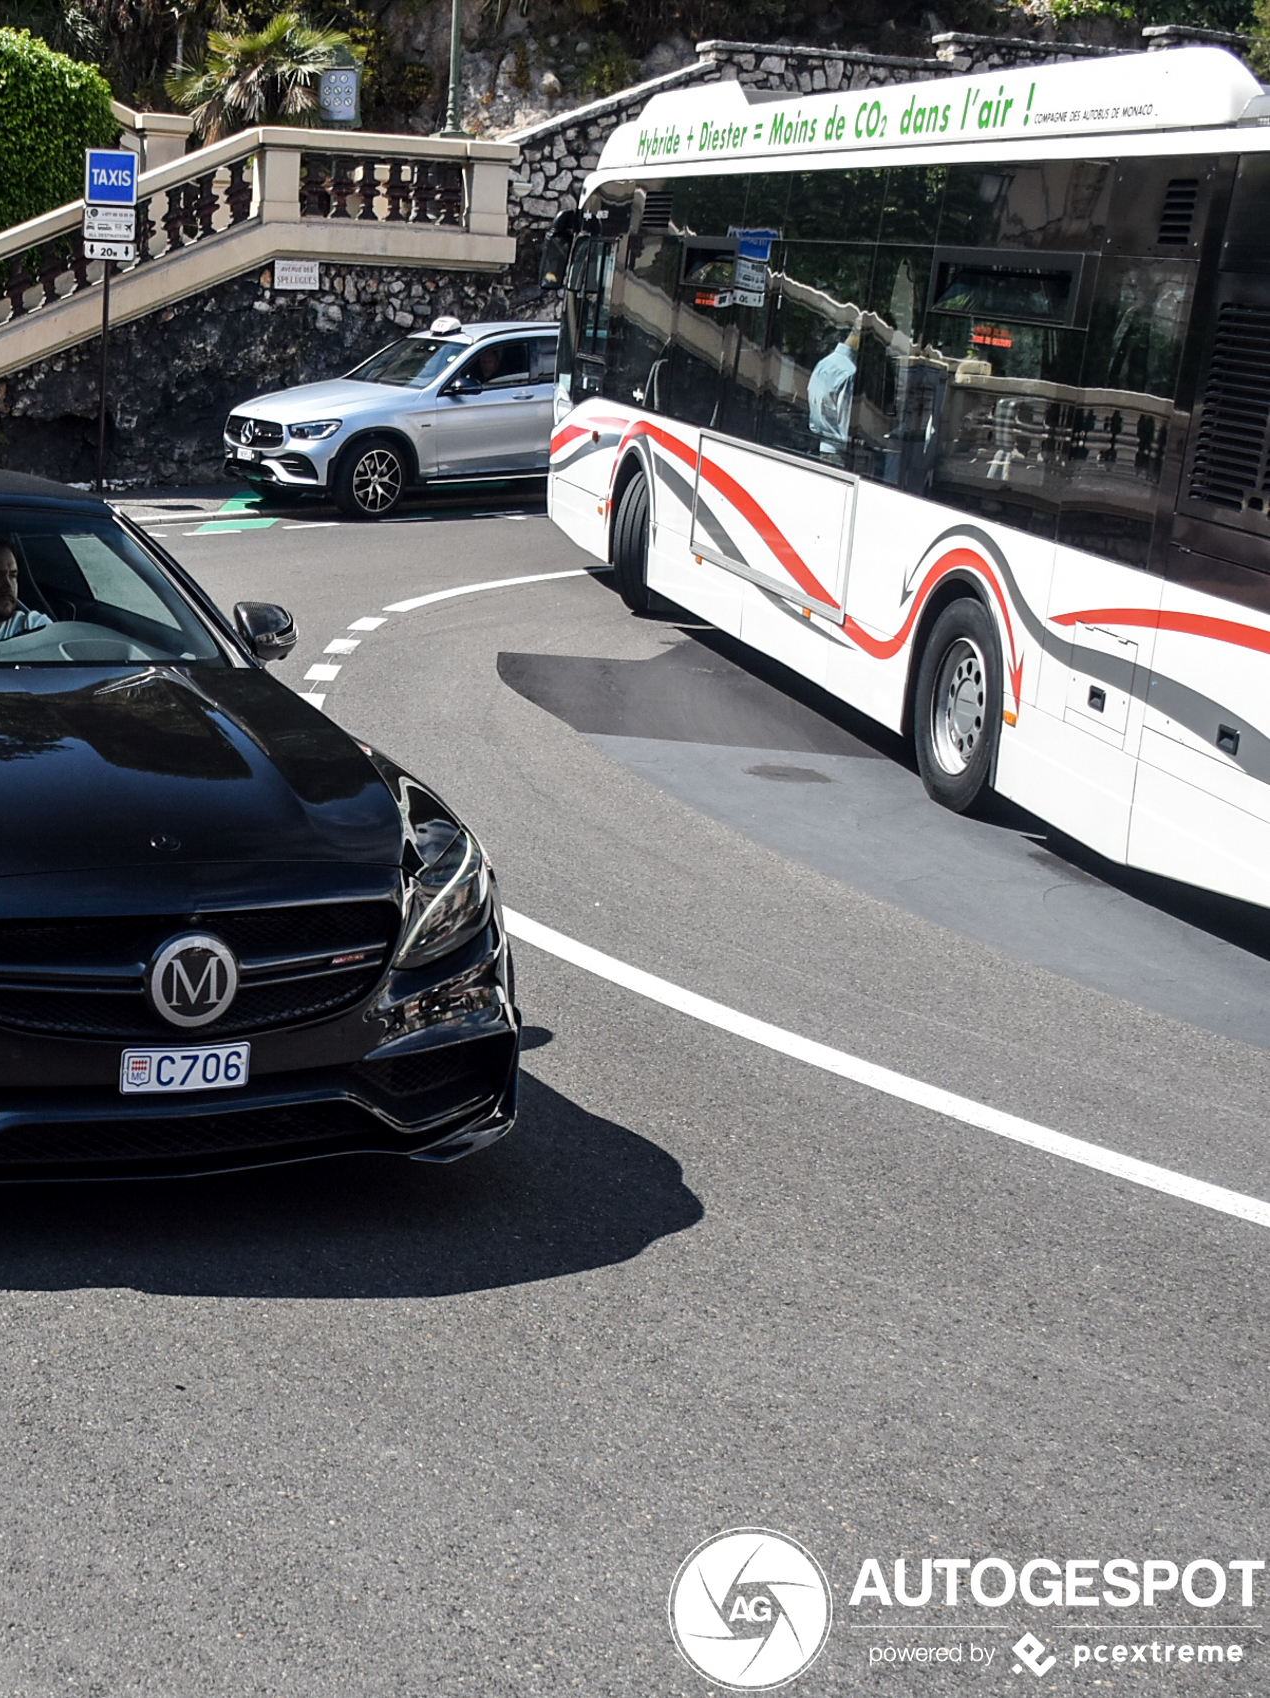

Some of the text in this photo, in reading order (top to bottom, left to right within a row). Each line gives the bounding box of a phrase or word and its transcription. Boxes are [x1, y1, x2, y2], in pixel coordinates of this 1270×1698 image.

[637, 125, 680, 164] Hybride
[699, 121, 747, 151] Diester
[768, 110, 817, 146] Moins
[824, 104, 845, 141] de
[900, 95, 951, 135] dans
[960, 85, 1013, 130] l'air
[1034, 112, 1068, 124] COMPAGNIE
[1070, 111, 1080, 122] DES
[1082, 108, 1110, 120] AUTOBUS
[1111, 107, 1120, 119] DE
[92, 169, 131, 186] TAXIS
[167, 956, 222, 1006] M
[131, 1072, 146, 1081] MC
[156, 1050, 242, 1086] C706
